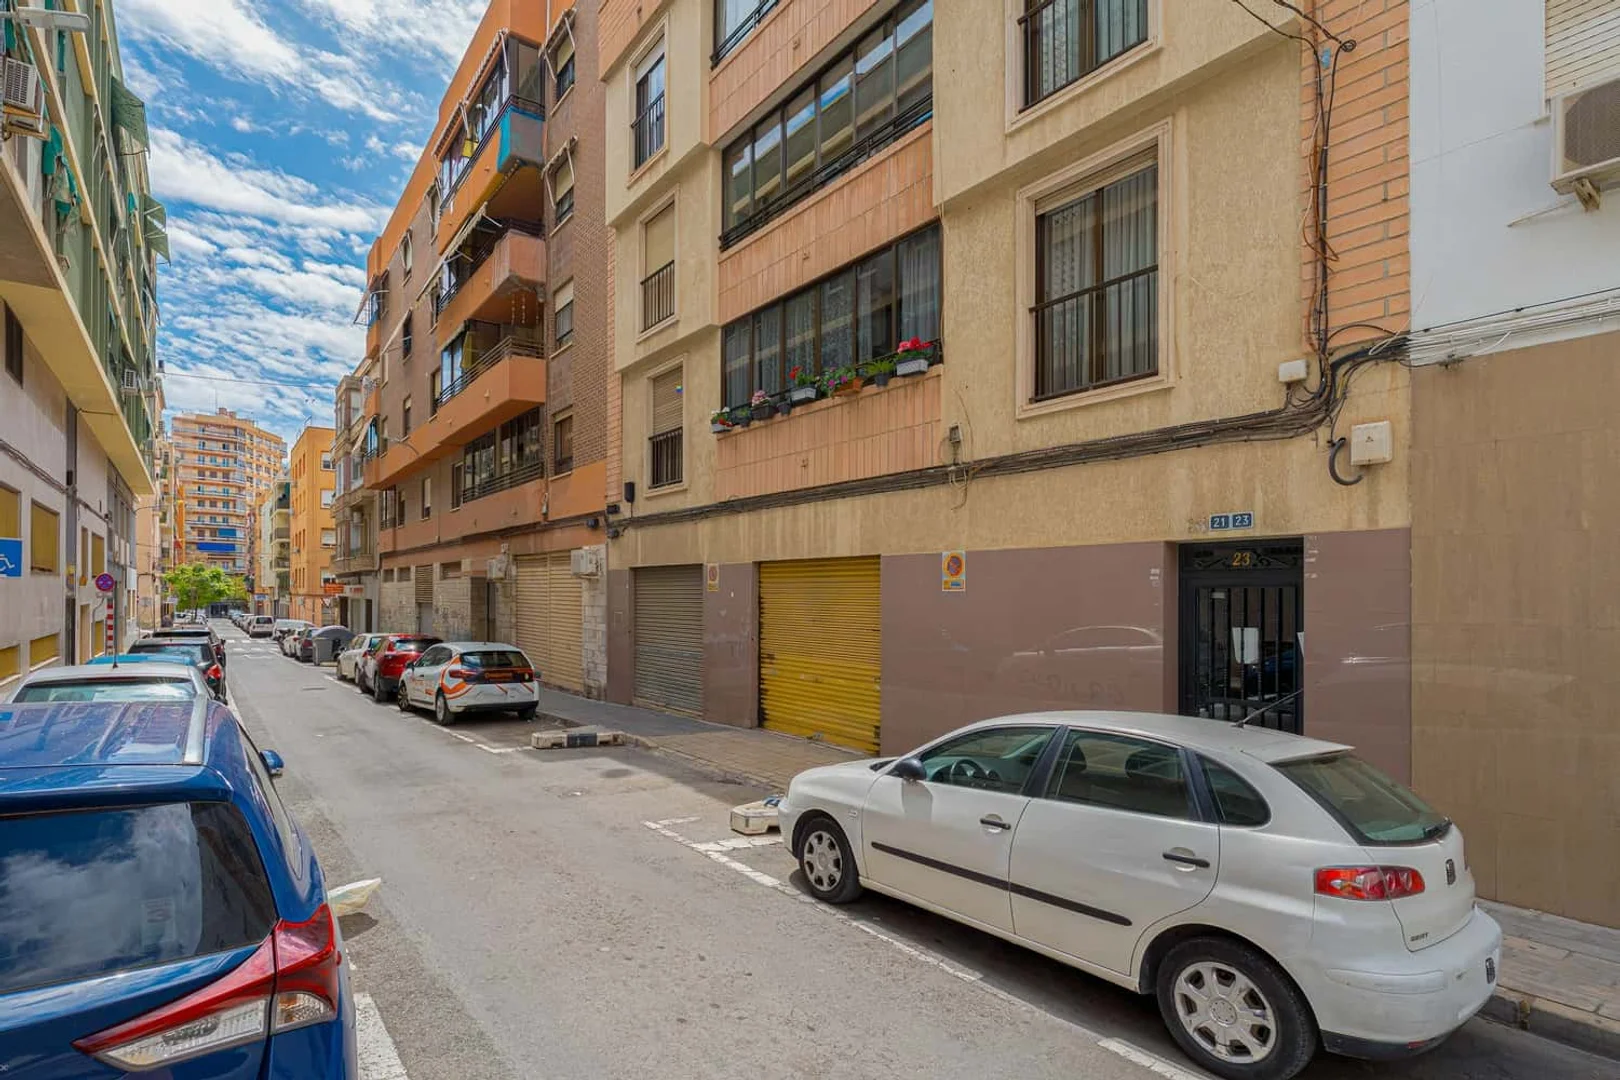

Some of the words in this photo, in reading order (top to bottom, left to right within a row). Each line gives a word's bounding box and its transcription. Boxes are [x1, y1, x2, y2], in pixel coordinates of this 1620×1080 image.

[1213, 517, 1226, 528] 21
[1235, 514, 1250, 527] 23
[1232, 552, 1251, 567] 23
